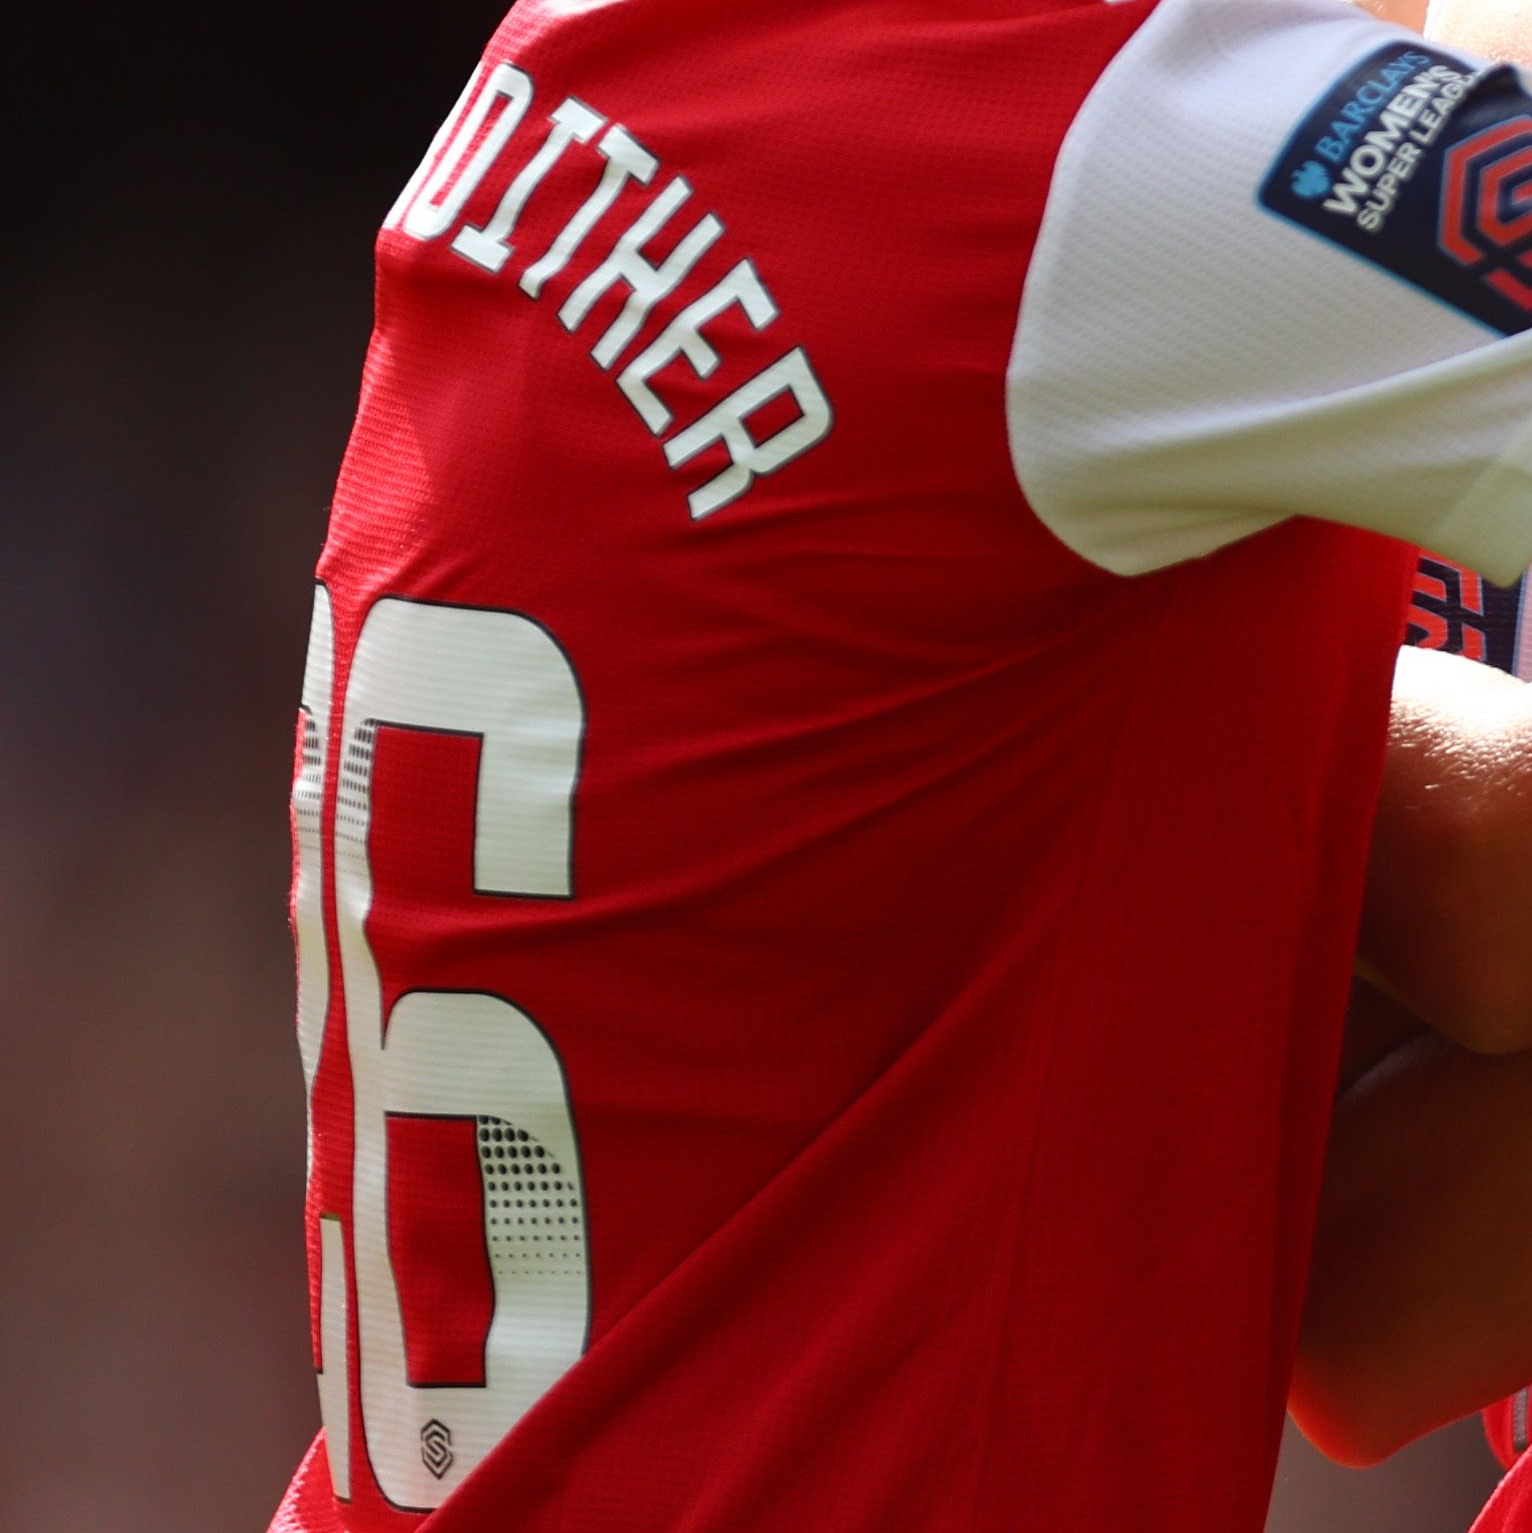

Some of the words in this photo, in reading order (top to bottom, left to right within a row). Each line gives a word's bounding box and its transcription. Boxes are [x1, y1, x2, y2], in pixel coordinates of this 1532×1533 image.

[1314, 50, 1432, 162] BARCLAYS
[1356, 141, 1422, 232] SUPER
[1409, 68, 1485, 145] LEAGU
[381, 60, 834, 522] OITHER
